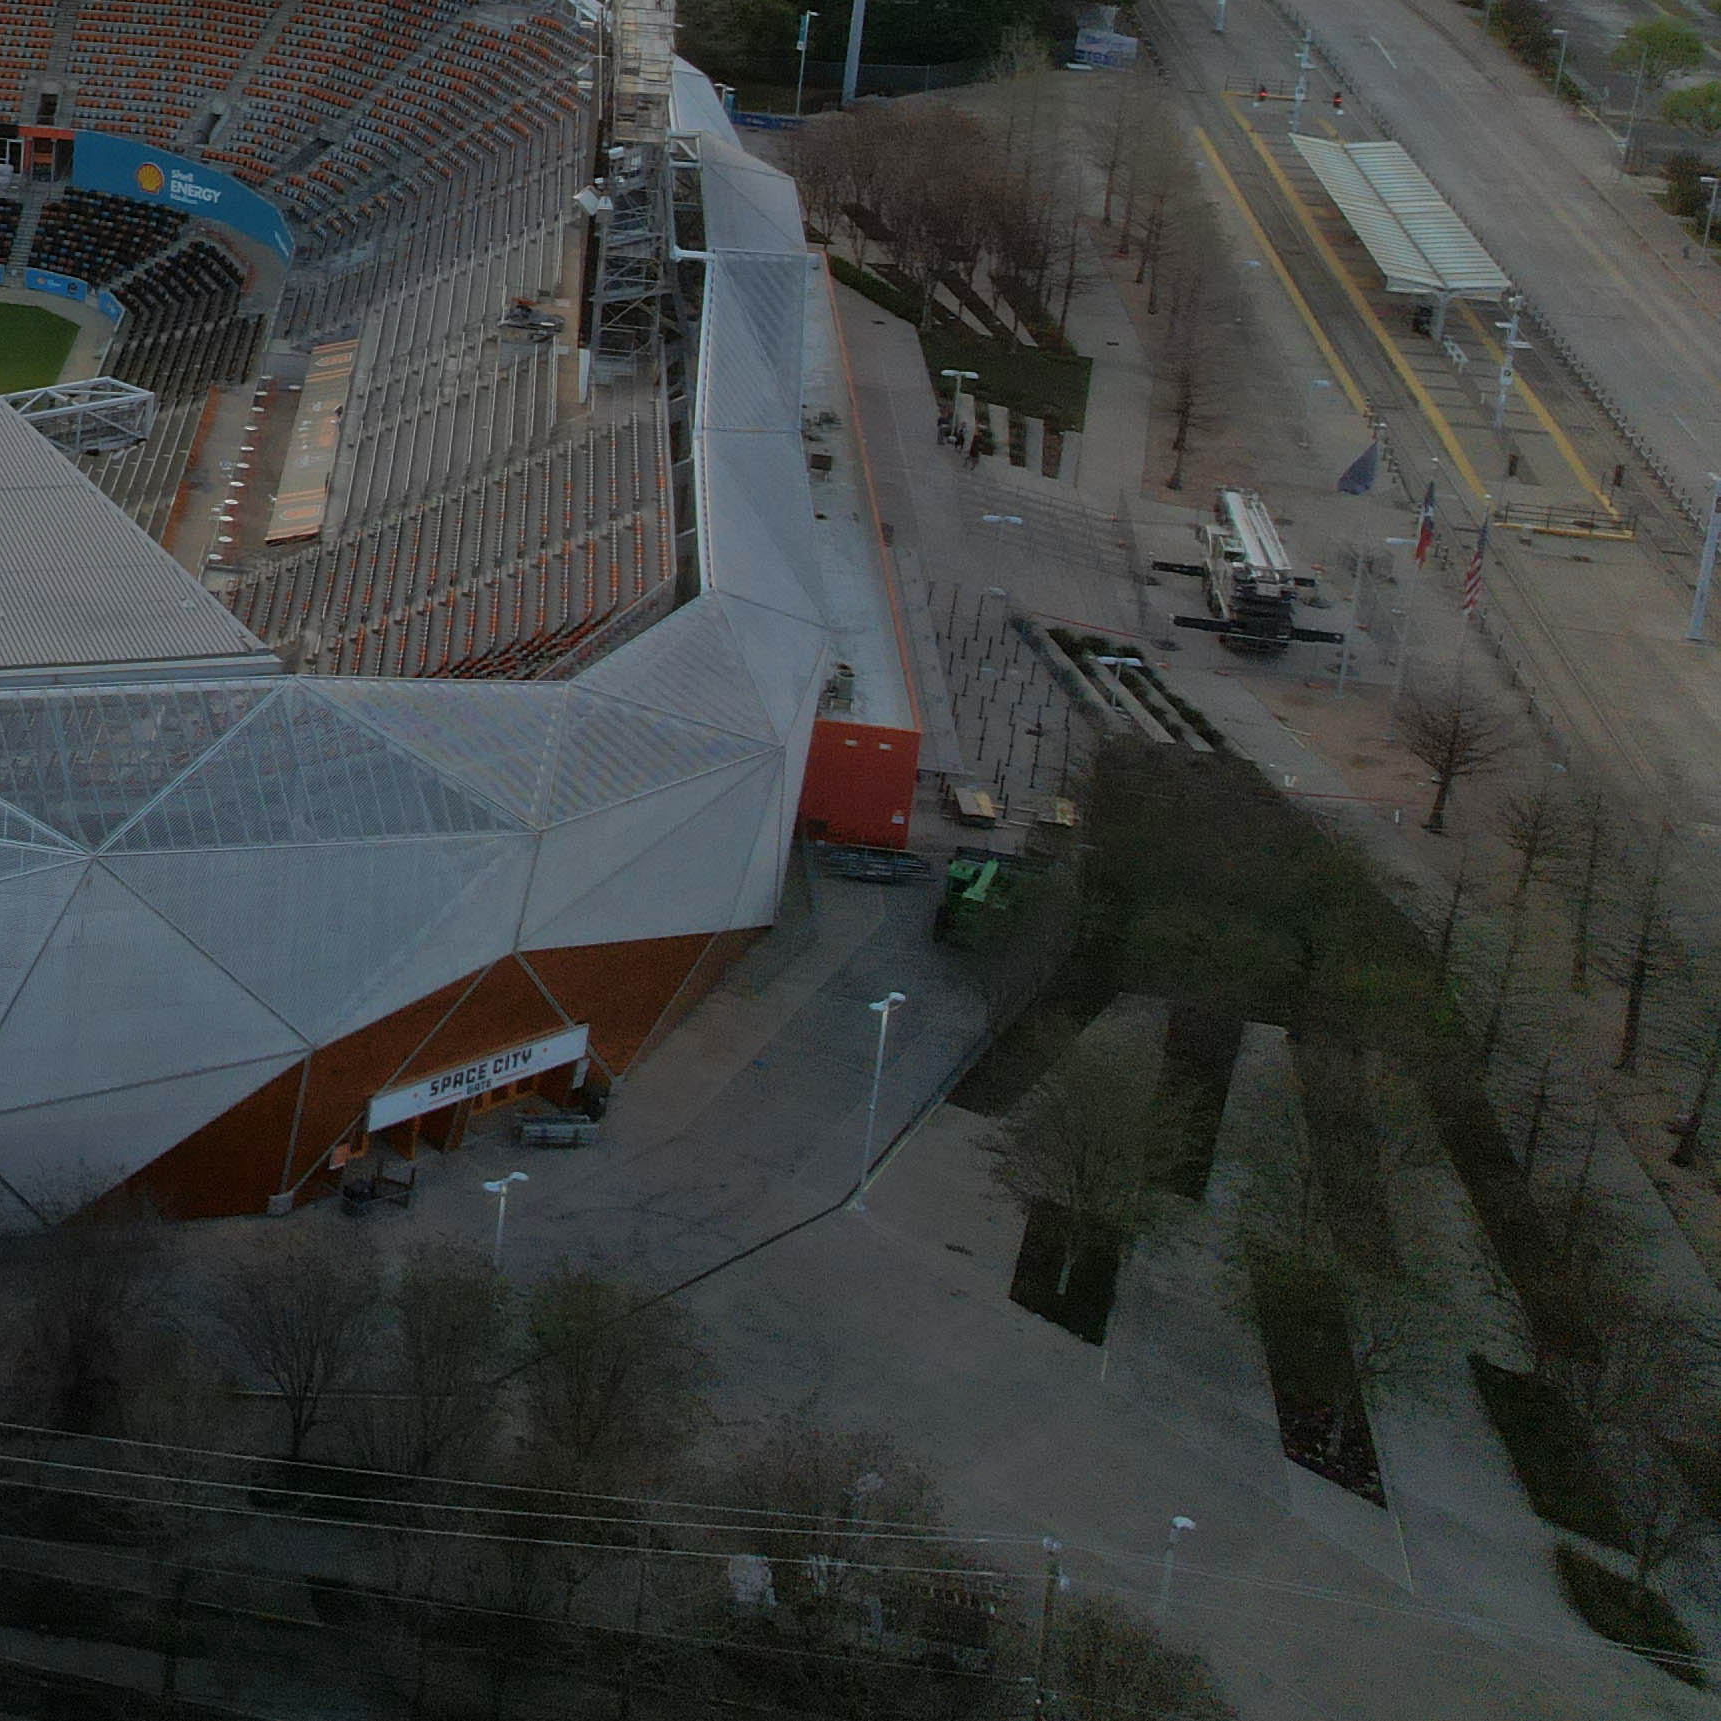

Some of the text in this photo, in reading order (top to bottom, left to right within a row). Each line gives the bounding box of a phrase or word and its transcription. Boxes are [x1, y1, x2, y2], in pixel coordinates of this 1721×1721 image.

[170, 179, 222, 204] ENERGY
[430, 1048, 532, 1096] SPACE CITY
